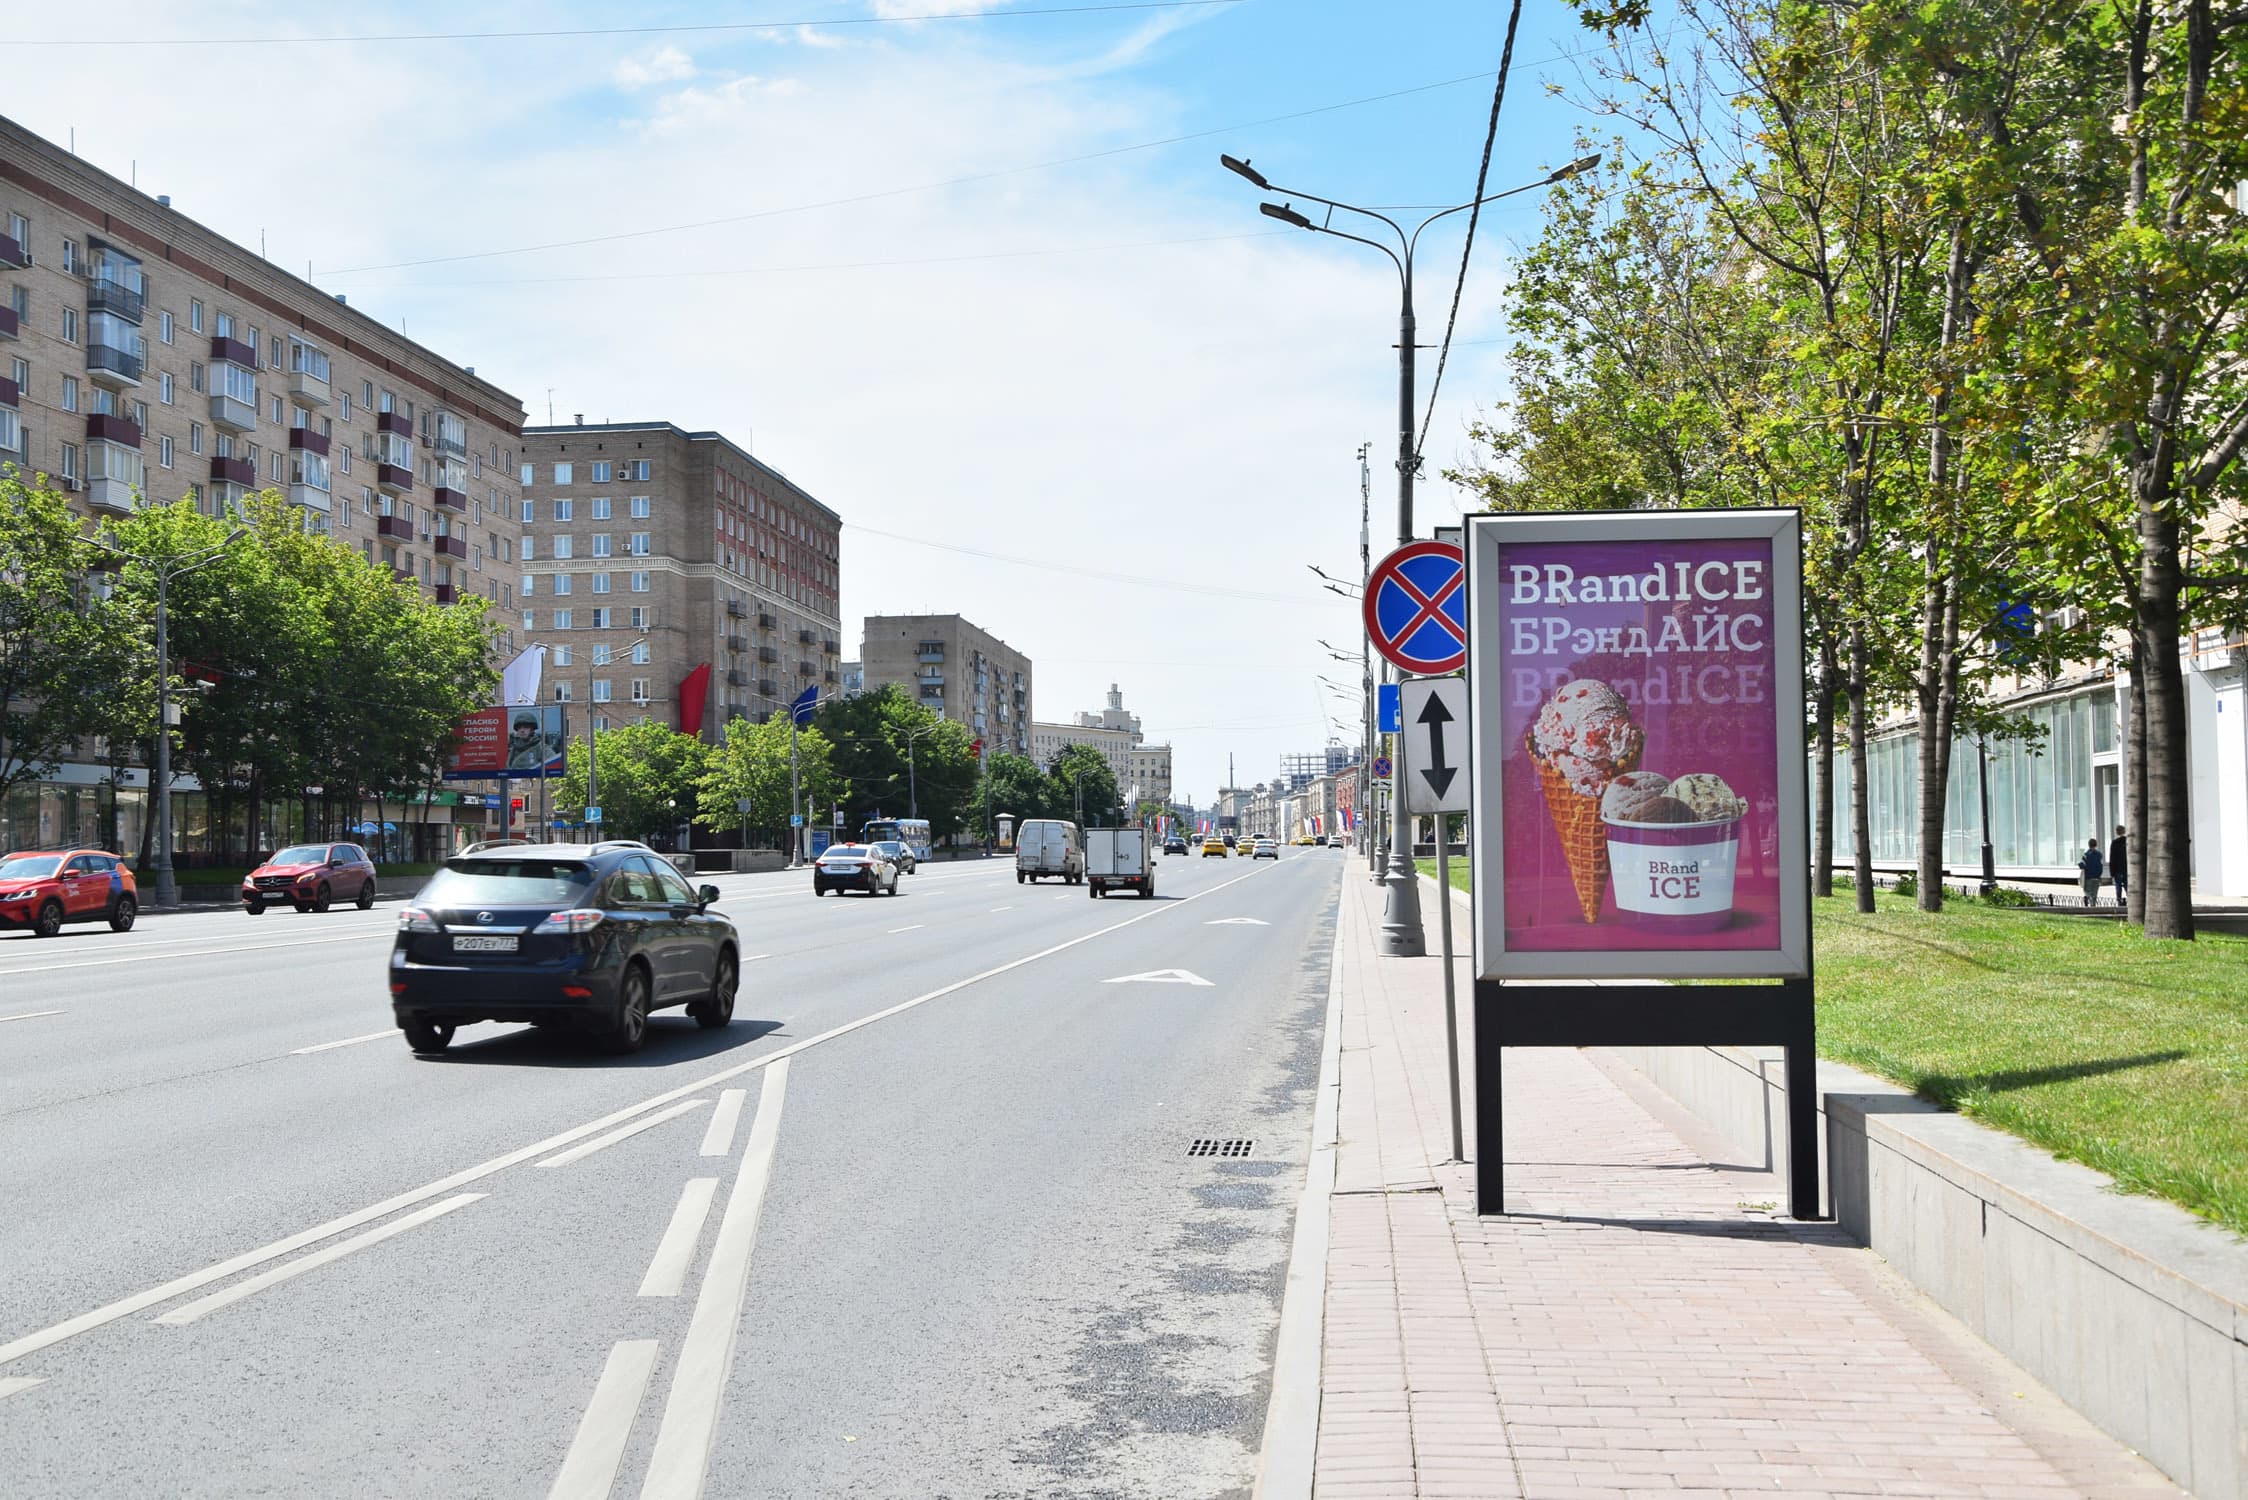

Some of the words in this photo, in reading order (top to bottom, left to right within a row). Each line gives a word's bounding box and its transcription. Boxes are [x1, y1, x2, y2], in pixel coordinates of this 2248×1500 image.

[1510, 561, 1763, 604] BRandICE
[1510, 606, 1763, 657] БРэндАЙС
[1511, 664, 1764, 707] BndICE
[1649, 861, 1699, 874] BRand
[1649, 876, 1701, 899] ICE
